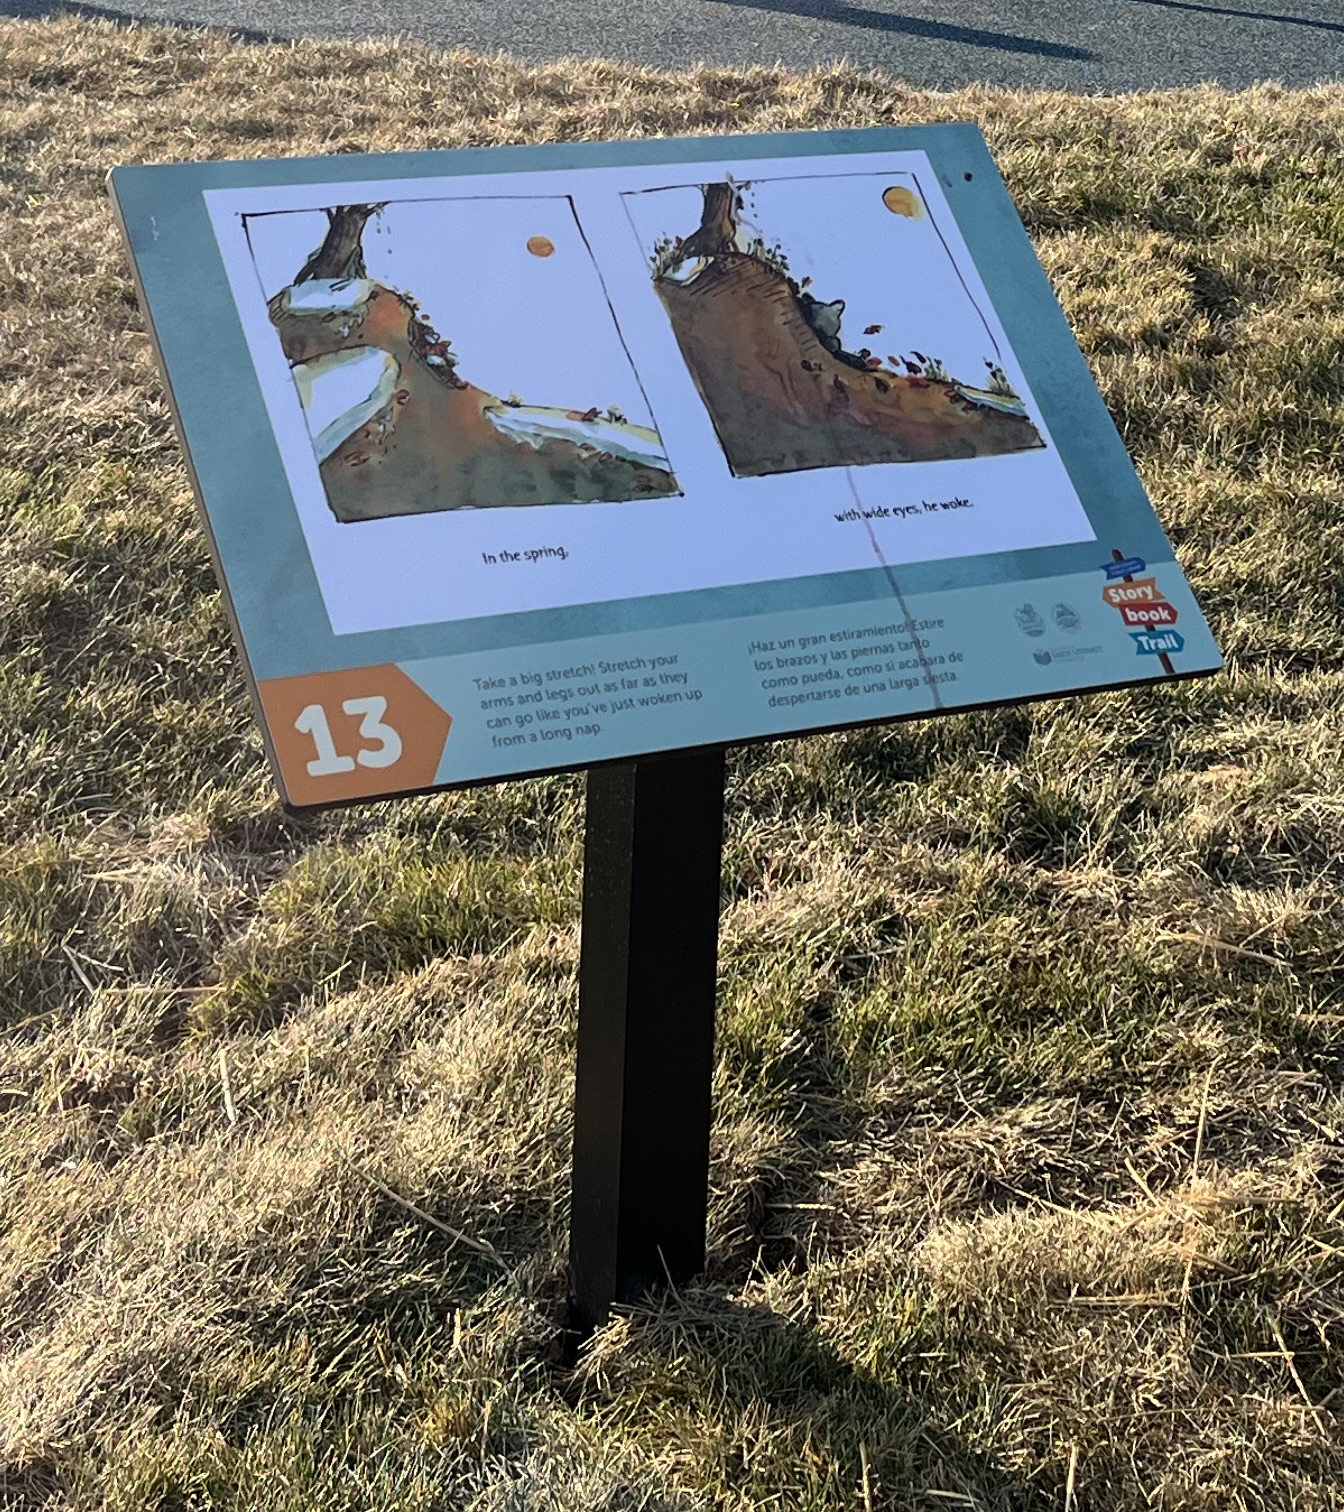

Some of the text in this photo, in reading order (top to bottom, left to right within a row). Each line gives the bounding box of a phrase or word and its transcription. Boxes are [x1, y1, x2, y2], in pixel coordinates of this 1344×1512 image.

[834, 497, 974, 522] with wide eyes, he woke.
[483, 552, 496, 565] In
[499, 550, 521, 562] the
[1109, 584, 1154, 603] Story
[1125, 607, 1171, 622] book
[778, 638, 795, 648] un
[798, 635, 825, 649] gran
[911, 618, 944, 631] Estire
[1137, 633, 1179, 650] Trail
[754, 638, 930, 672] los brazos y las piernas tanto
[761, 651, 964, 689] como pueda, como si acabara de
[472, 654, 678, 691] Take a big stretch! Stretch your
[480, 672, 688, 710] arms and legs out as far as they
[768, 689, 841, 708] despertarse
[844, 686, 859, 697] de
[863, 683, 886, 693] una
[889, 678, 920, 691] larga
[486, 689, 702, 729] can go like you've just woken up
[295, 696, 402, 776] 13
[492, 734, 526, 748] from
[530, 733, 537, 743] a
[540, 727, 572, 741] long
